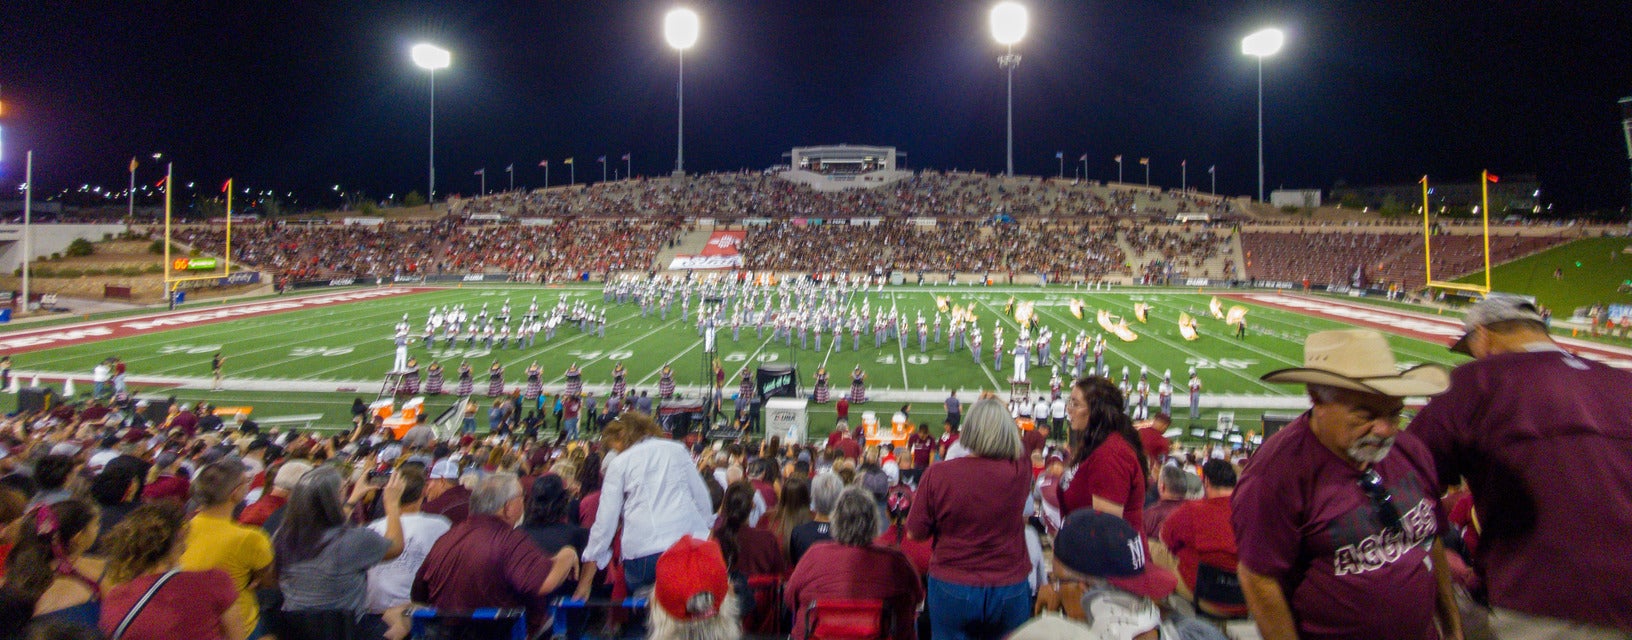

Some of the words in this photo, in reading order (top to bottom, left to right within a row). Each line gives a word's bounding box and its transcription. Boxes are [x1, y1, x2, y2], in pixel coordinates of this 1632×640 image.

[724, 351, 780, 363] 50
[876, 353, 929, 365] 40
[1333, 497, 1437, 577] AGGIES
